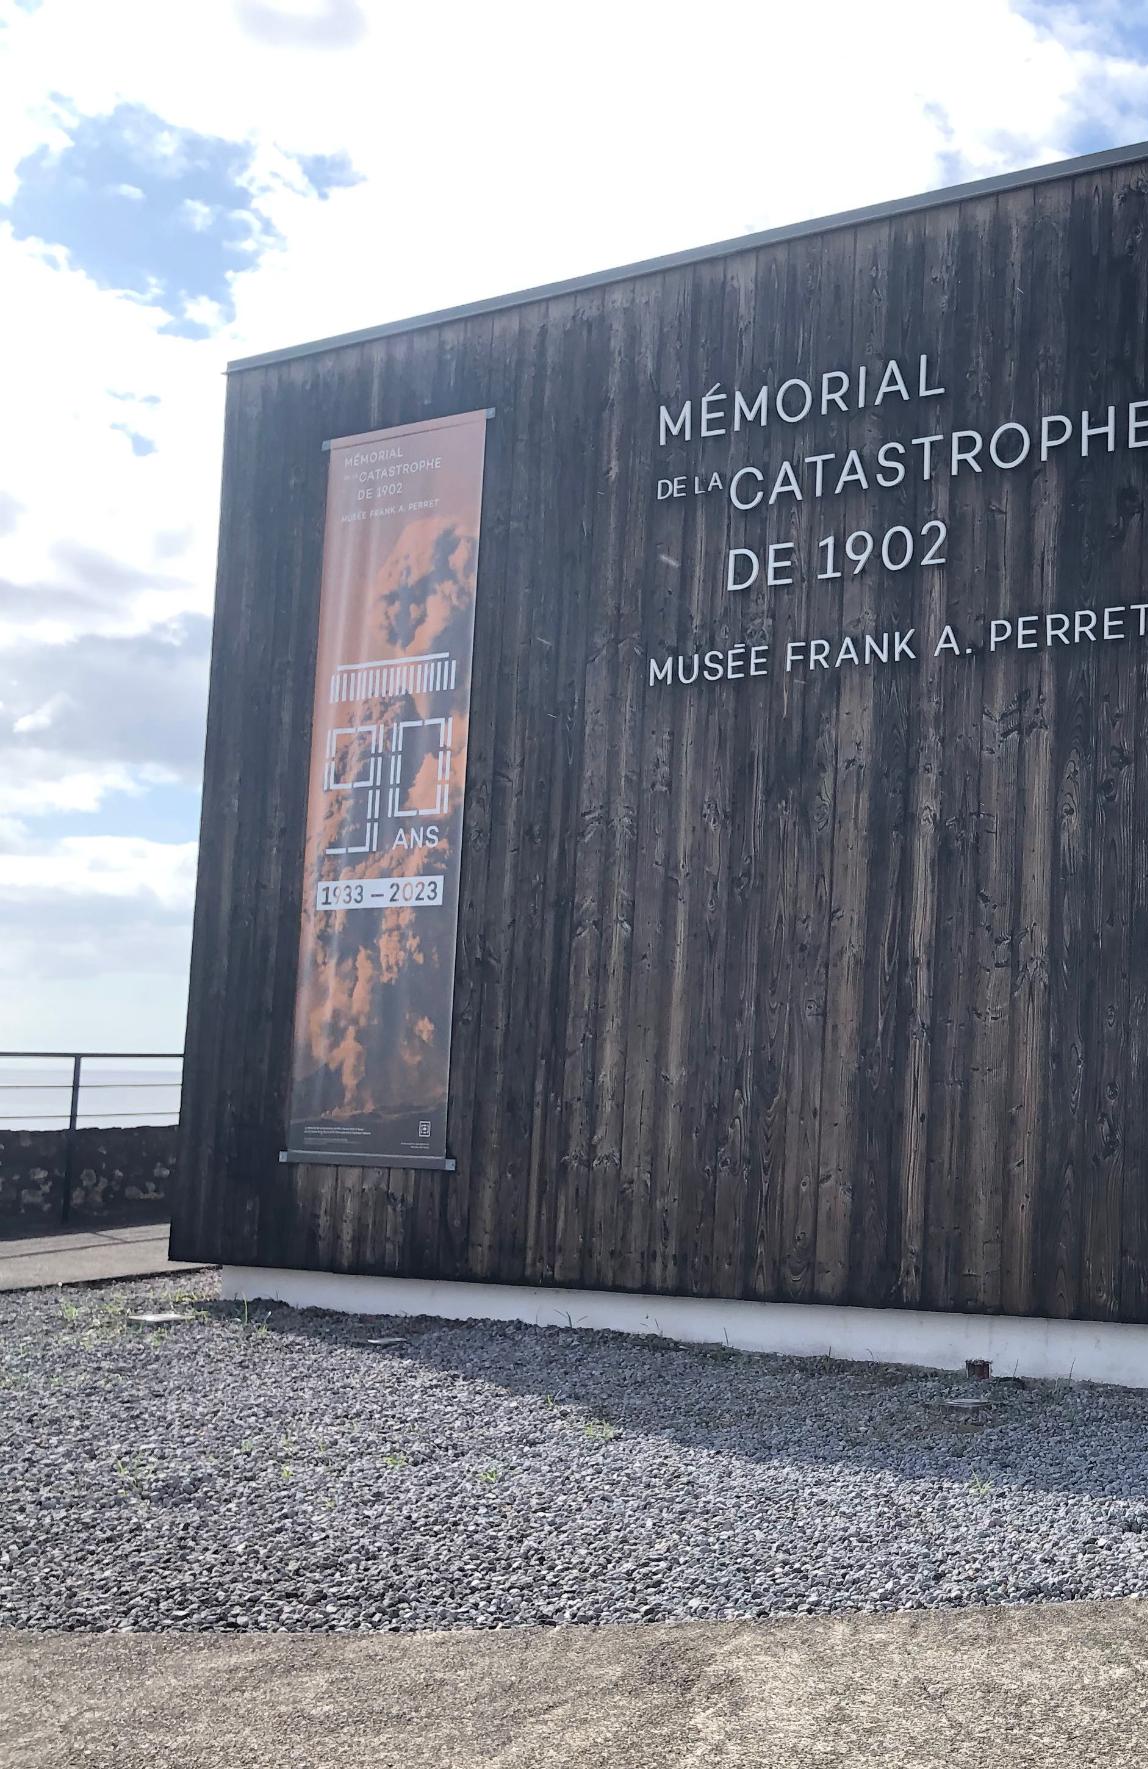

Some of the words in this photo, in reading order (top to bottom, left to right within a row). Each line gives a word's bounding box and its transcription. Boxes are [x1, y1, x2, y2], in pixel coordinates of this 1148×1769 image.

[659, 354, 945, 446] MÉMORIAL
[344, 448, 403, 468] MÉMORIAL
[359, 457, 442, 482] CATASTROPHE
[358, 488, 374, 500] DE
[376, 482, 403, 498] 1902
[657, 476, 687, 500] DE
[694, 472, 723, 495] LA
[369, 506, 397, 520] FRANK
[408, 498, 440, 511] PERRET
[727, 541, 795, 592] DE
[816, 519, 948, 581] 1902
[649, 643, 769, 687] MUSÉE
[785, 628, 916, 672] FRANK
[934, 624, 972, 657] A.
[392, 825, 440, 850] ANS
[321, 884, 364, 906] 1933
[389, 881, 439, 902] 2023
